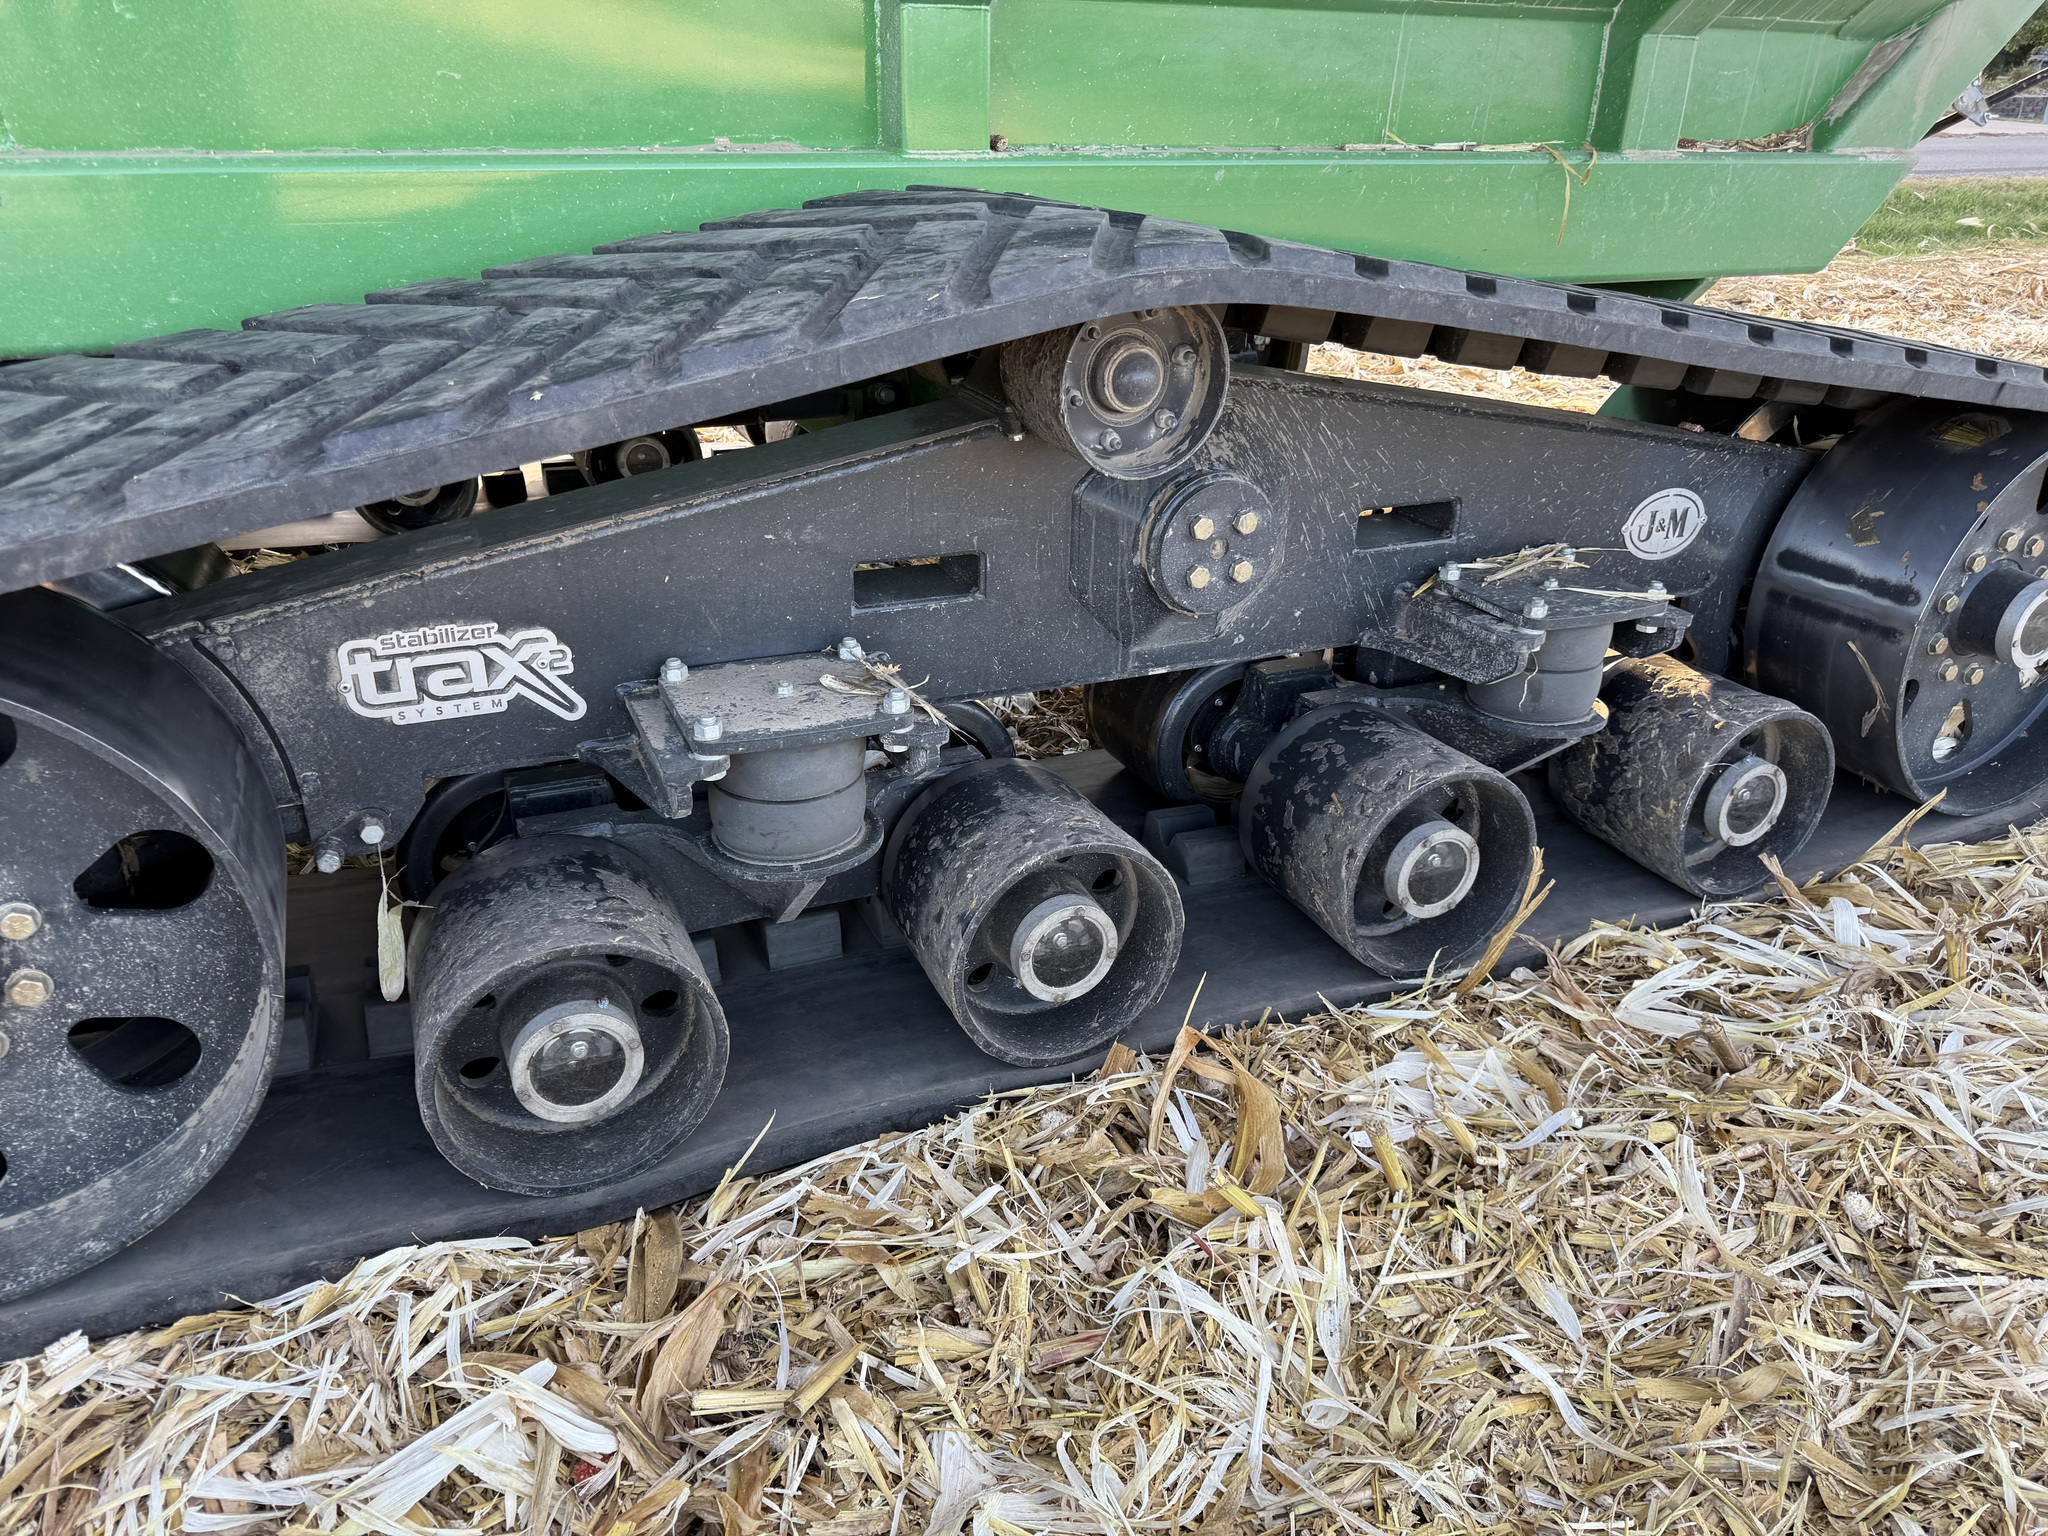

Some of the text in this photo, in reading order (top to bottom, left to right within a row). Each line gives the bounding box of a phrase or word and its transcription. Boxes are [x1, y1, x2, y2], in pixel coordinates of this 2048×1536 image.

[1637, 507, 1691, 543] J&M
[380, 624, 496, 651] stabilizer
[398, 698, 503, 721] SYSTEM
